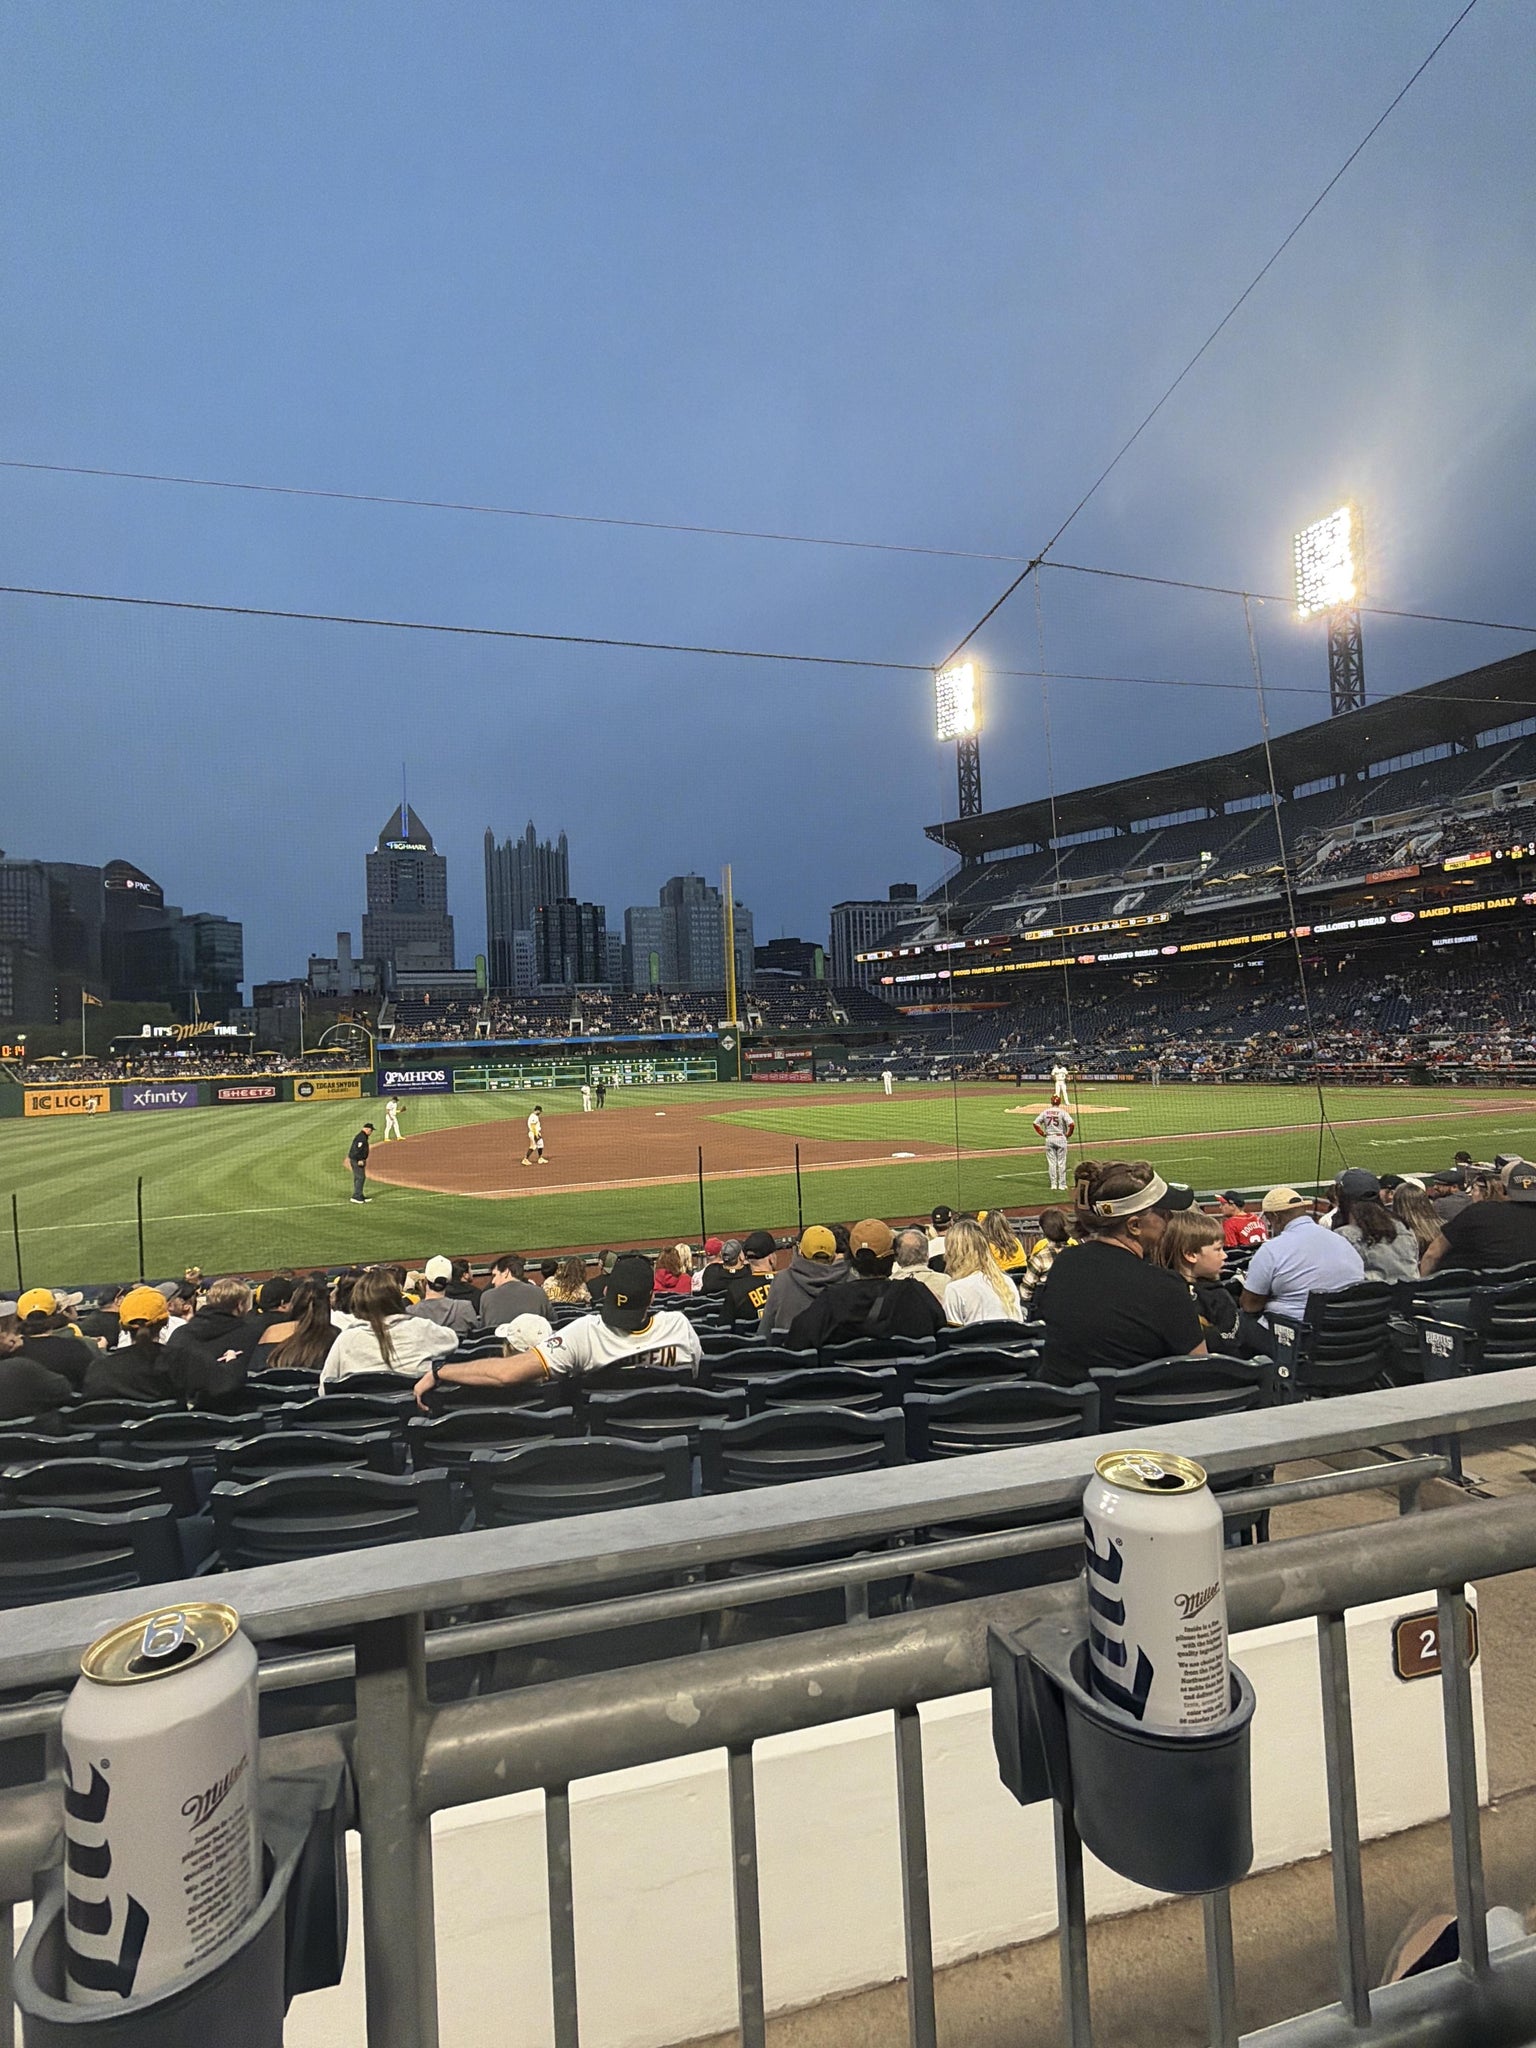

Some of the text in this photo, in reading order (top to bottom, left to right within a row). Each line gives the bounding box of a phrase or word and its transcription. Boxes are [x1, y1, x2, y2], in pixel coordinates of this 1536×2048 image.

[134, 881, 150, 891] PNC
[1419, 907, 1451, 919] BAKED
[1452, 902, 1485, 914] FRESH
[1487, 897, 1517, 909] DAILY
[1180, 941, 1217, 952] HOMETOWN
[1218, 936, 1250, 947] FAVORITE
[1251, 933, 1272, 943] SINCE
[170, 1020, 222, 1042] Miller
[214, 1026, 238, 1036] TIME
[315, 1081, 335, 1089] EDGAR
[335, 1080, 359, 1088] SNYDER
[133, 1089, 188, 1107] xfinity
[222, 1087, 274, 1098] SHEETZ
[55, 1094, 103, 1107] LIGHT
[1046, 1116, 1060, 1127] 75
[1522, 1179, 1532, 1189] P
[617, 1293, 628, 1307] P
[1174, 1581, 1219, 1617] Miller
[1184, 1624, 1202, 1633] Inside
[1175, 1634, 1196, 1642] pilsner
[1419, 1629, 1440, 1659] 2
[1177, 1650, 1198, 1658] quality
[1181, 1675, 1211, 1684] Northwest
[1188, 1684, 1204, 1692] noble
[1202, 1706, 1214, 1714] with
[1188, 1716, 1210, 1724] calories
[181, 1754, 248, 1825] Miller
